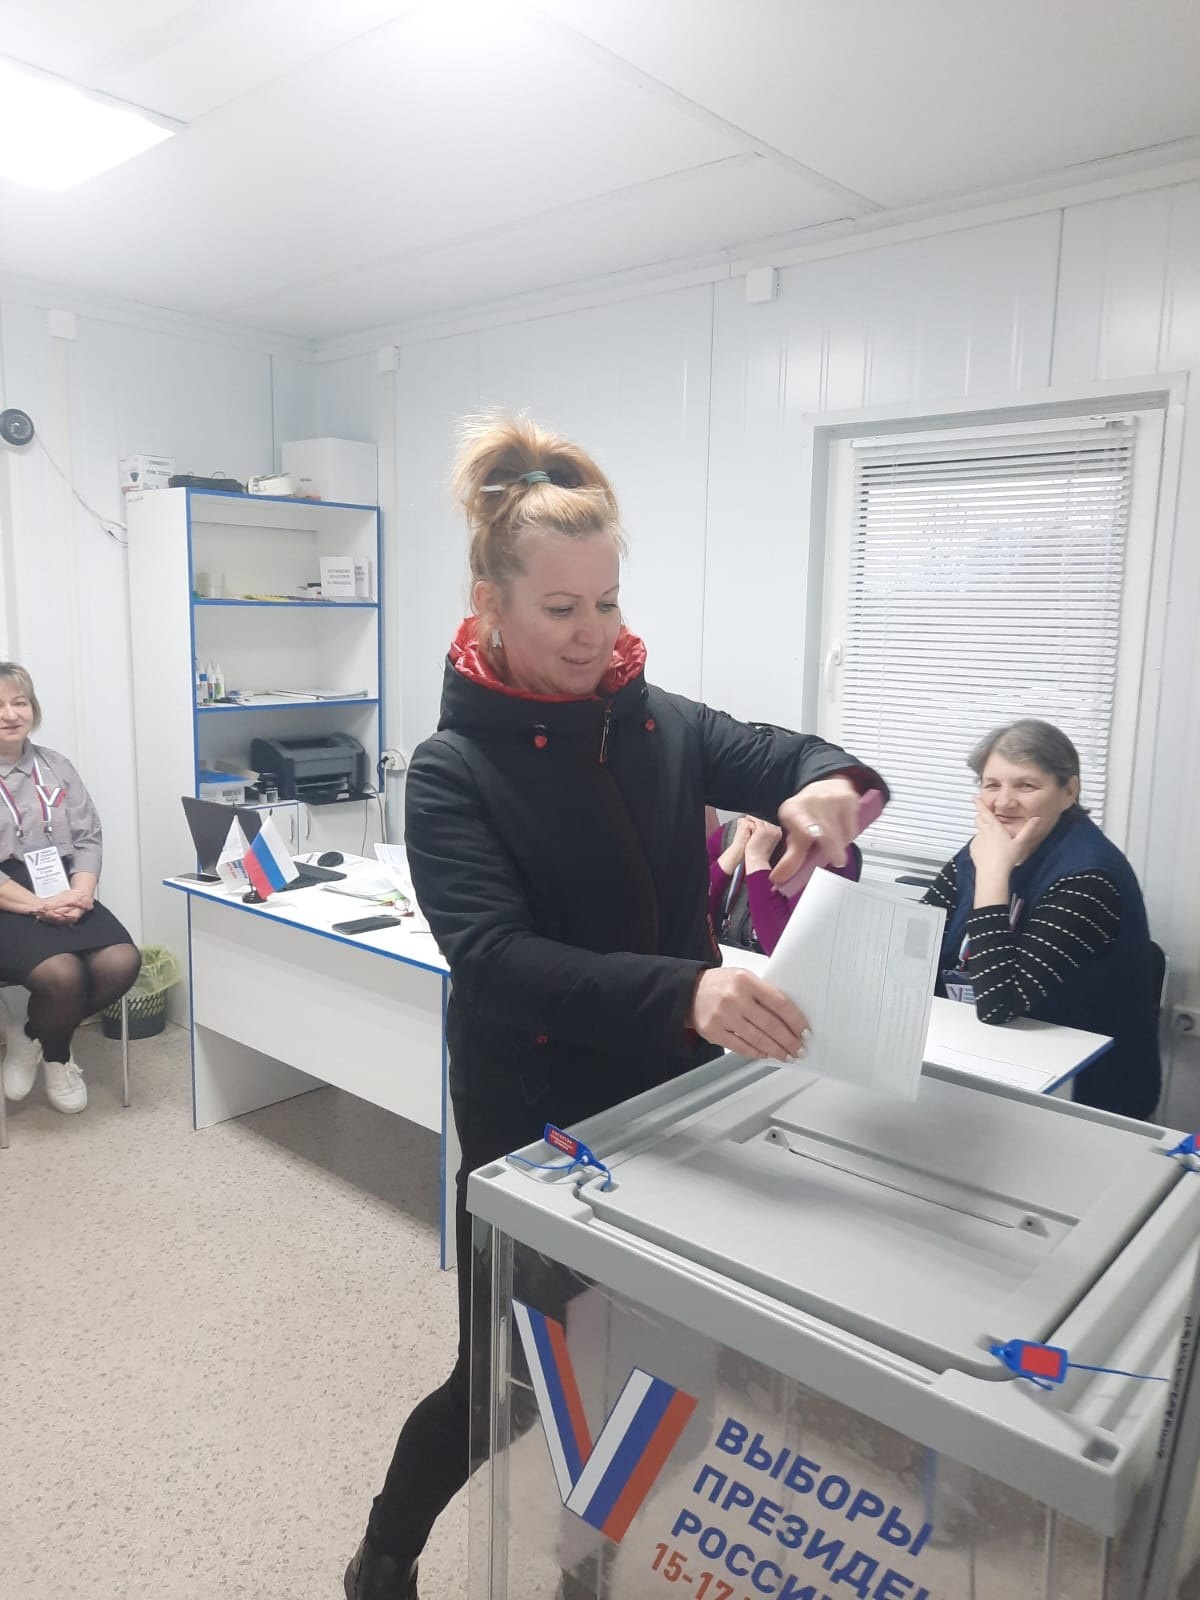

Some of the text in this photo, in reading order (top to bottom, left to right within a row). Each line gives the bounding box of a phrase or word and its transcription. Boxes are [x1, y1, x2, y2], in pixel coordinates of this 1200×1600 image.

[692, 1463, 930, 1600] ПРЕЗИДЕ
[714, 1417, 933, 1557] ВЫБОРЫ
[651, 1543, 735, 1600] 15-17
[671, 1508, 833, 1600] РОССИ
